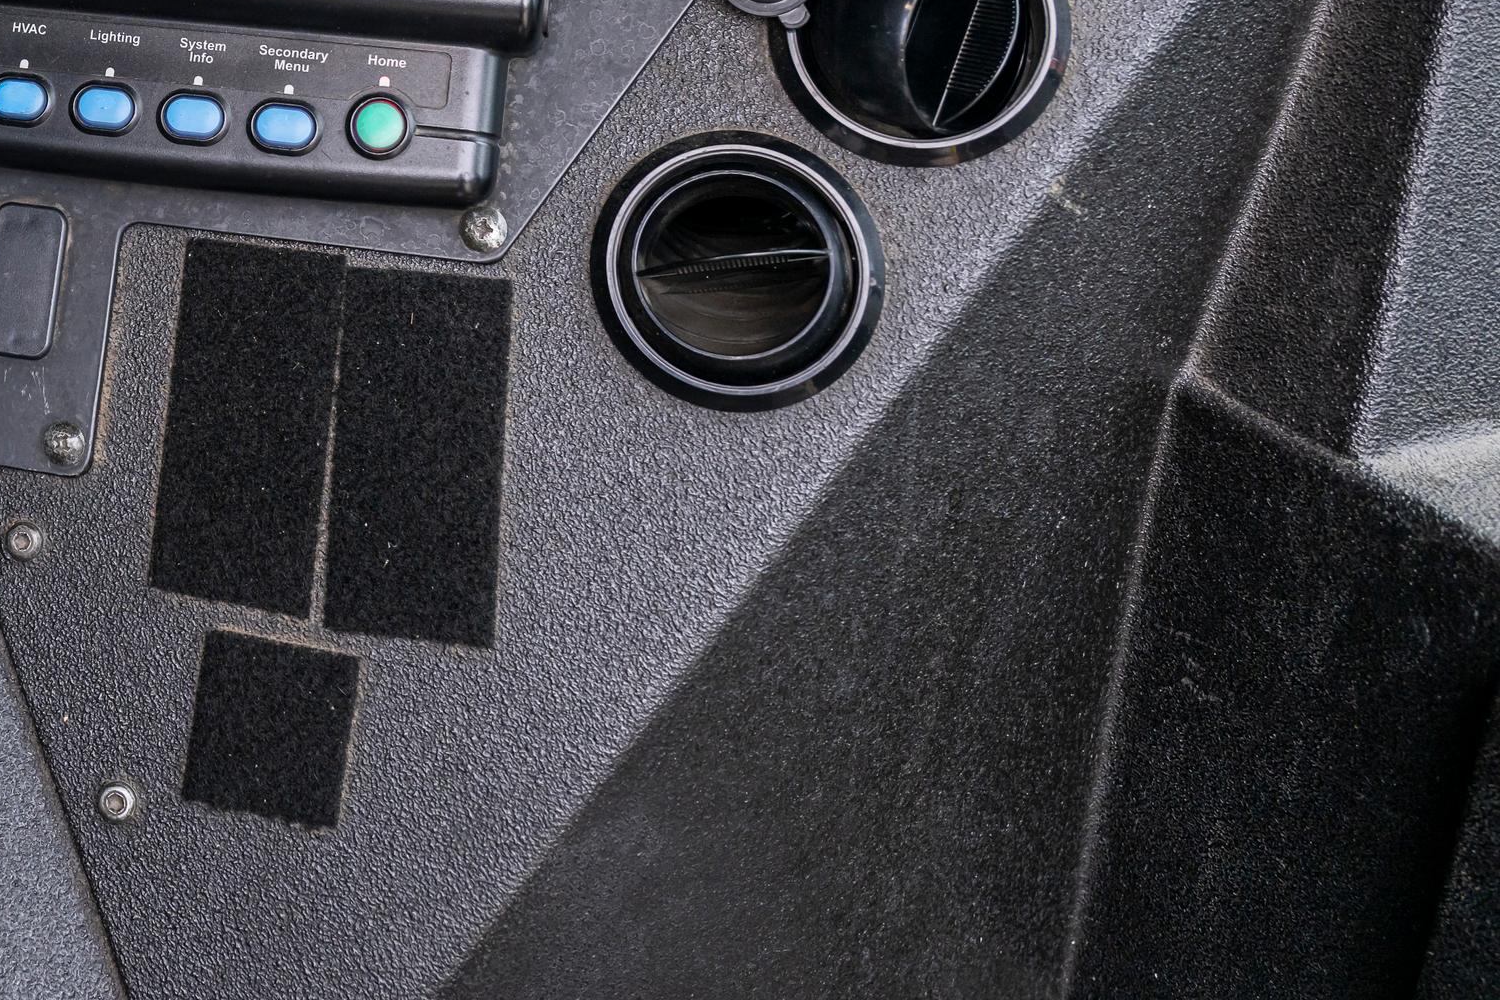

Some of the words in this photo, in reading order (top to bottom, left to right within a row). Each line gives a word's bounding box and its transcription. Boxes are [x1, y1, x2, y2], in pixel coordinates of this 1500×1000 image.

[12, 22, 47, 35] HVAC
[90, 29, 141, 46] Lighting
[179, 37, 227, 52] System
[189, 51, 214, 64] Info
[259, 44, 329, 63] Secondary
[274, 59, 310, 73] Menu
[367, 54, 407, 69] Home
